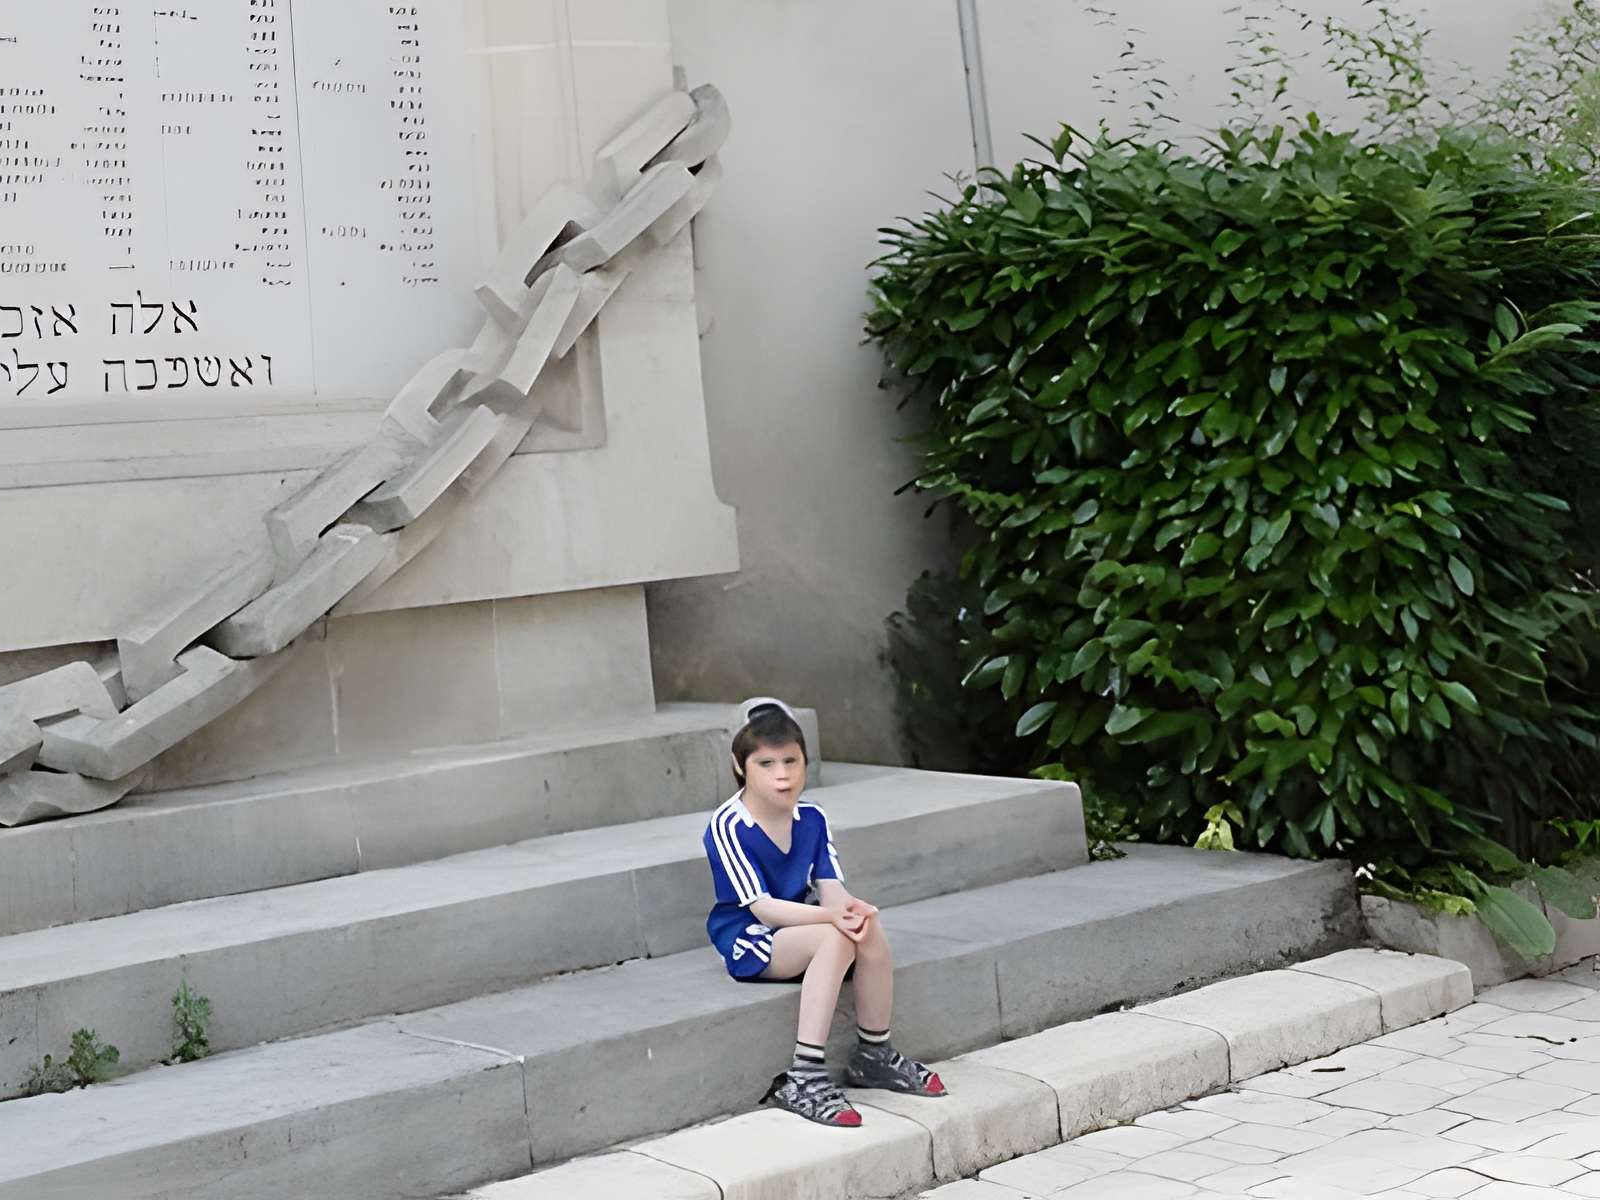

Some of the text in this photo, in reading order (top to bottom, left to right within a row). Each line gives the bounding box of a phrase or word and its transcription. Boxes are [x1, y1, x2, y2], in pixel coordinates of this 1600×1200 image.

[109, 289, 199, 335] אלה
[0, 347, 69, 397] עלי
[102, 354, 274, 393] ואשפכה
